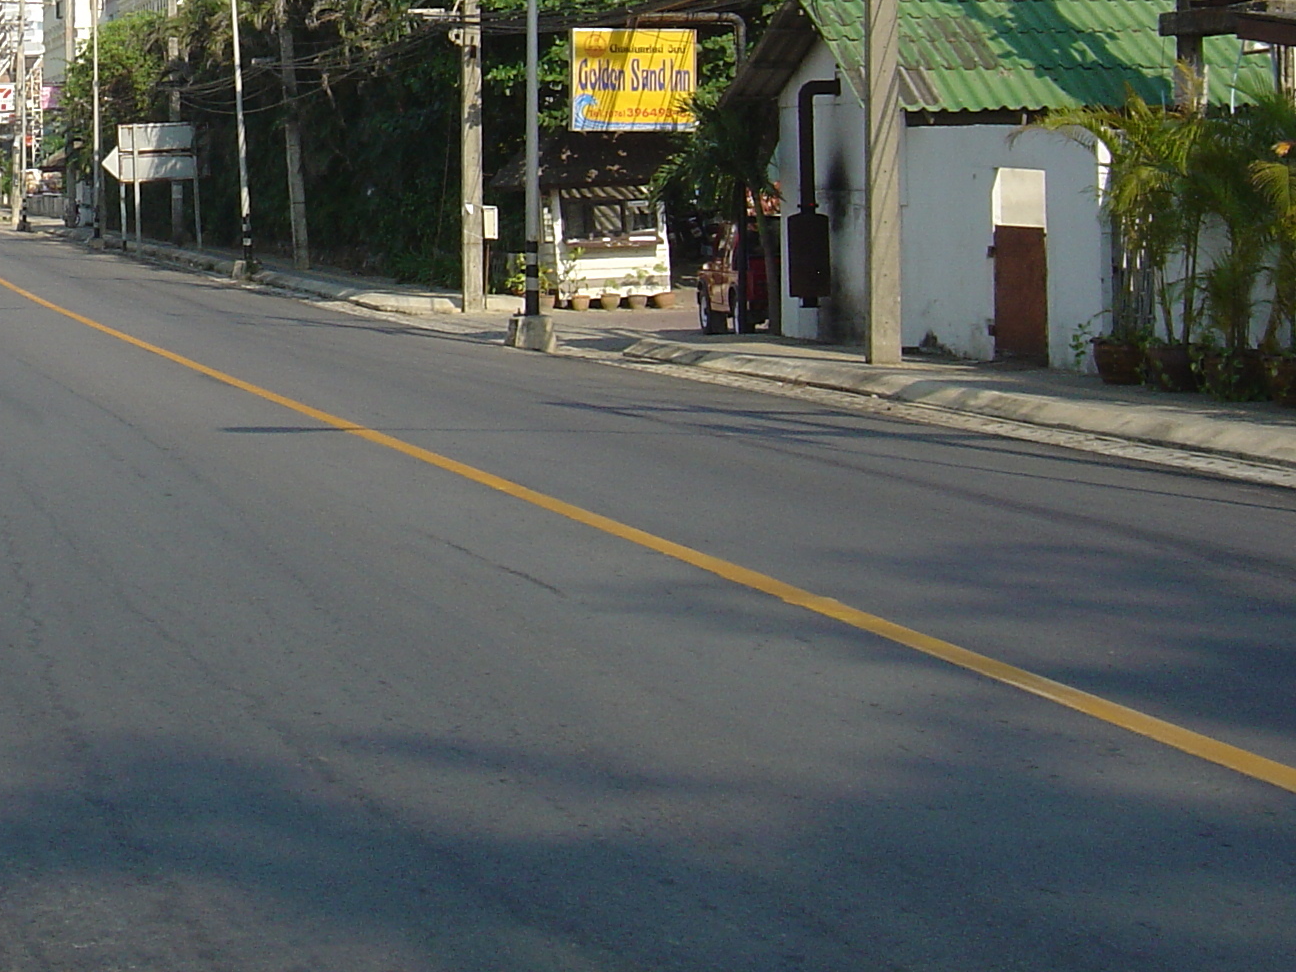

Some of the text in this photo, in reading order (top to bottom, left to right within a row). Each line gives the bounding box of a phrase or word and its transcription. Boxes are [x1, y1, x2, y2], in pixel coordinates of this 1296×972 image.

[578, 57, 691, 91] Golden Sand Inn
